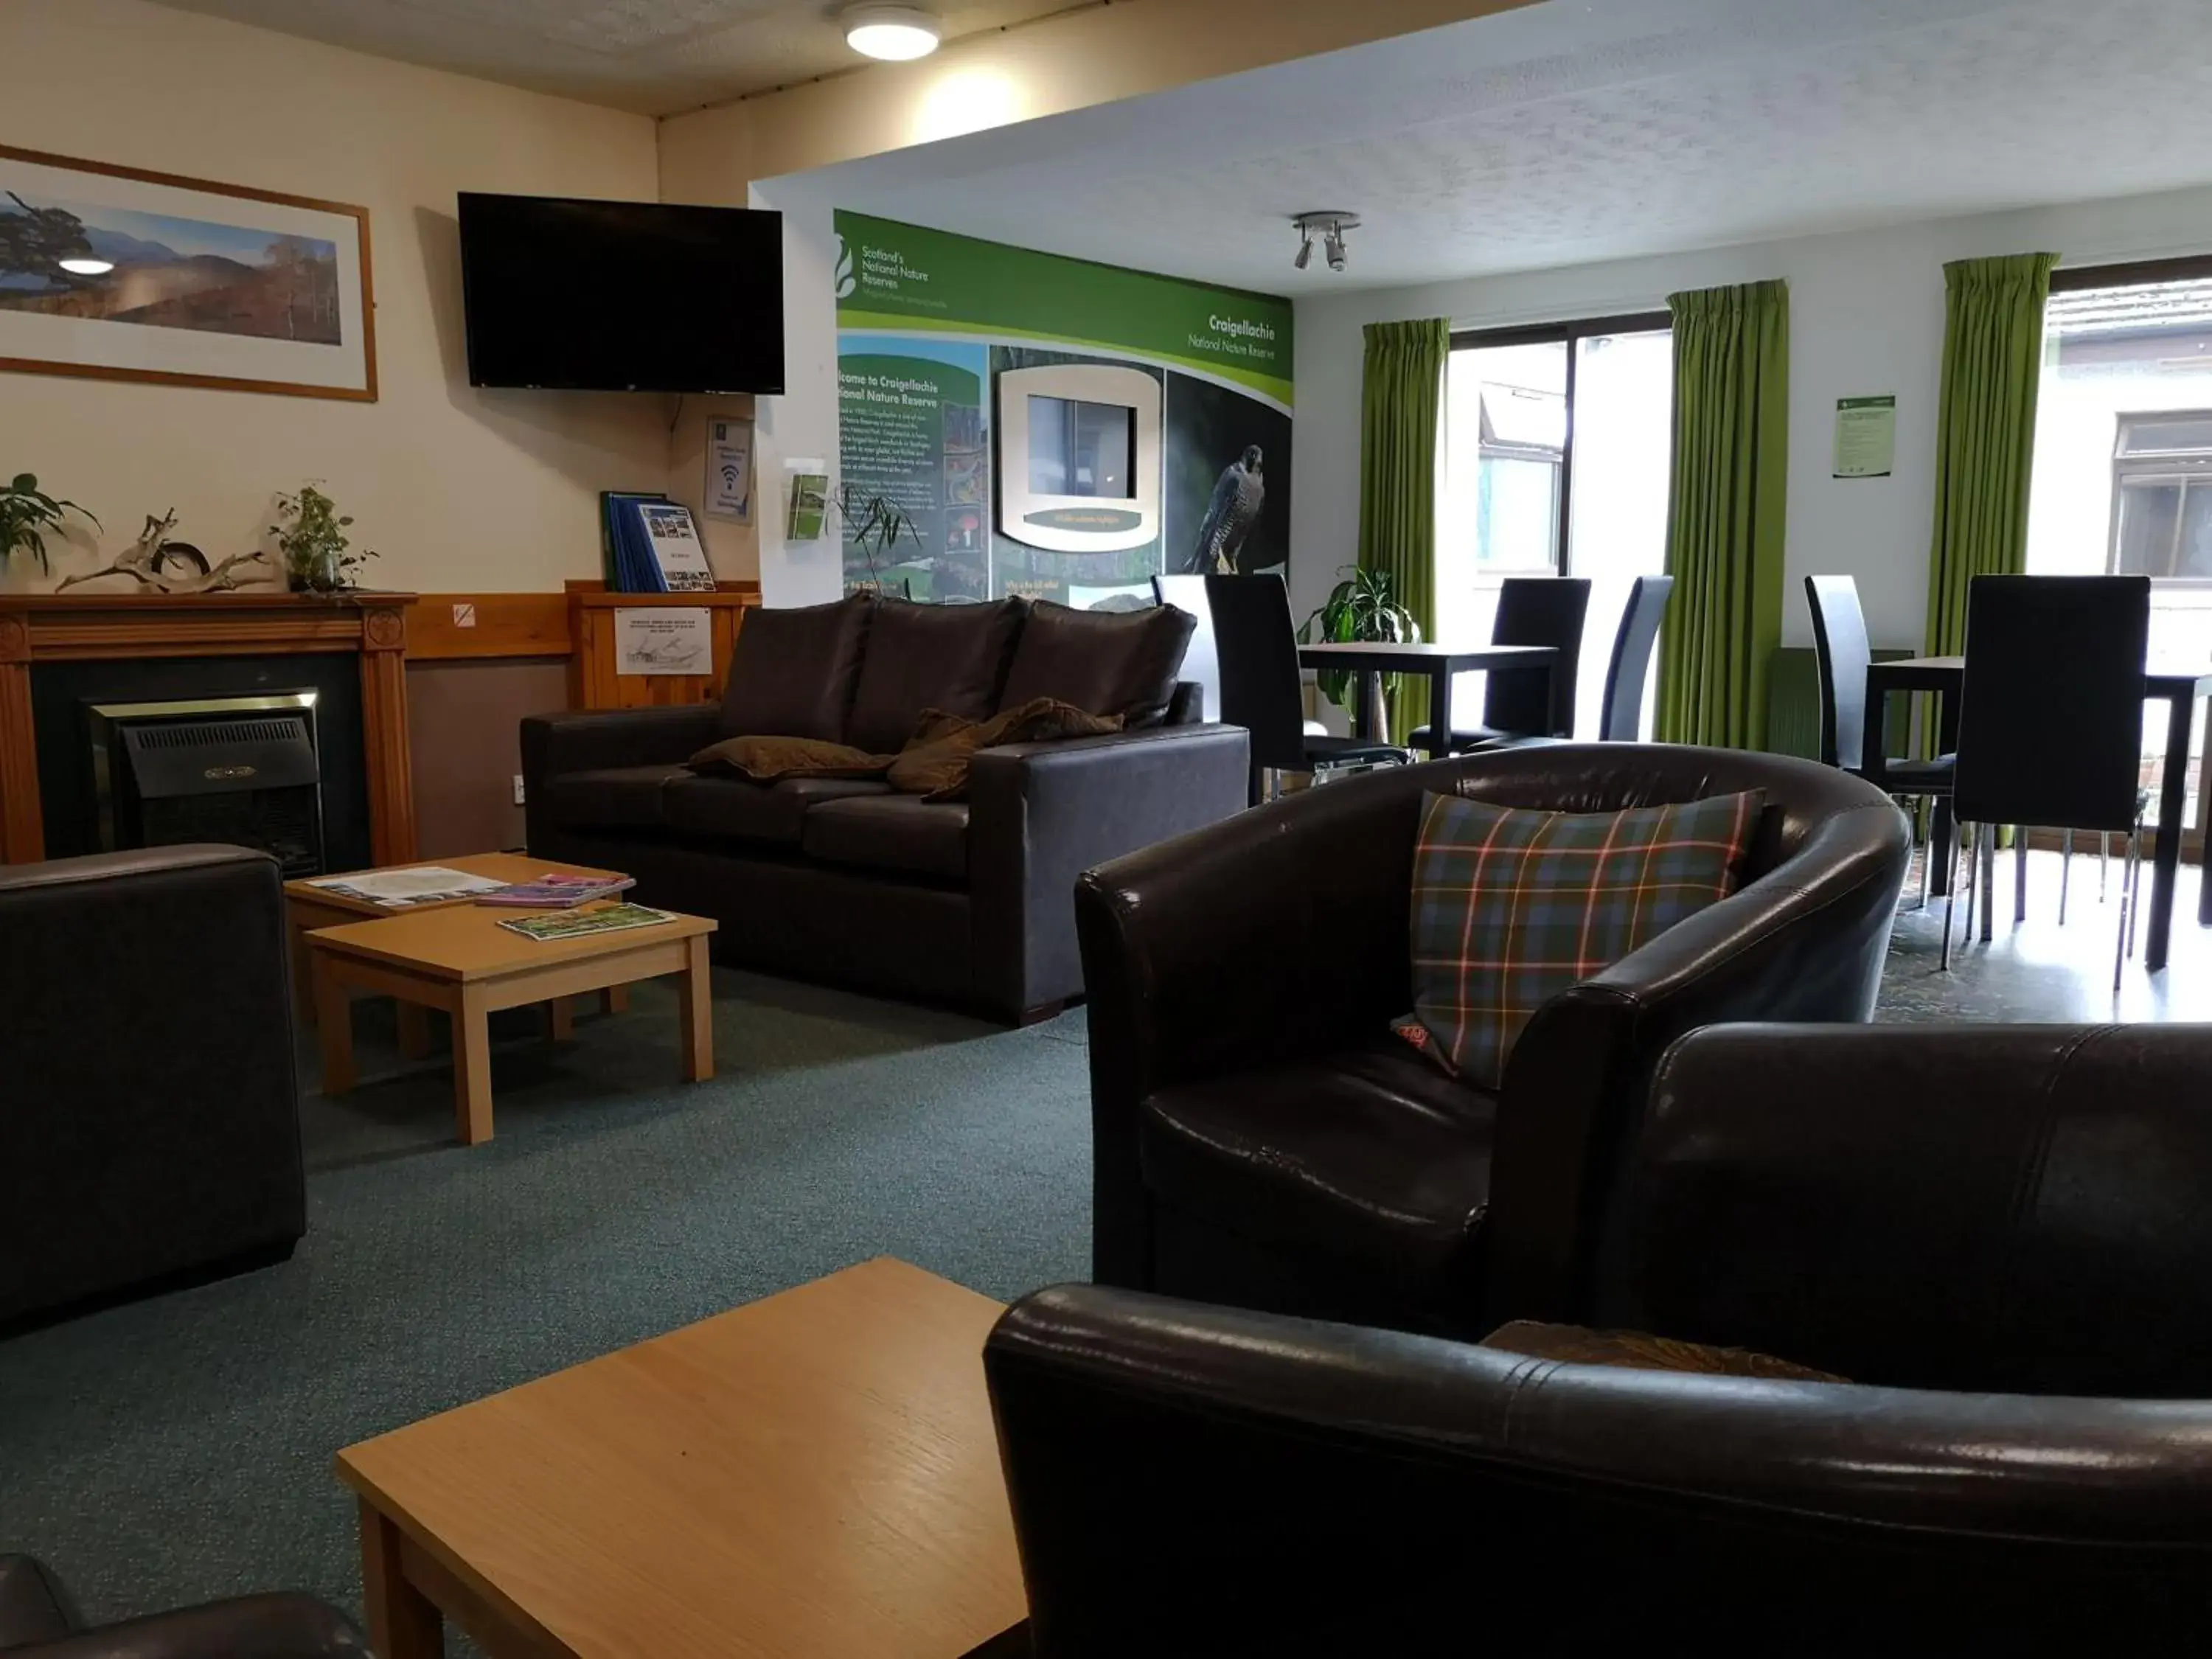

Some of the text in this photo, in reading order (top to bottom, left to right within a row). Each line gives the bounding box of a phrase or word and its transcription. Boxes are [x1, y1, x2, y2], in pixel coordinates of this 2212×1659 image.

[862, 245, 903, 264] Scotland's
[862, 260, 929, 282] National Nature
[862, 272, 898, 289] Reserves
[1208, 314, 1275, 341] Craigellachie
[1188, 334, 1221, 351] National
[1222, 340, 1247, 355] Nature
[838, 369, 939, 393] lcome to Craigellachie
[866, 389, 900, 404] Nature
[902, 394, 937, 408] Reserve
